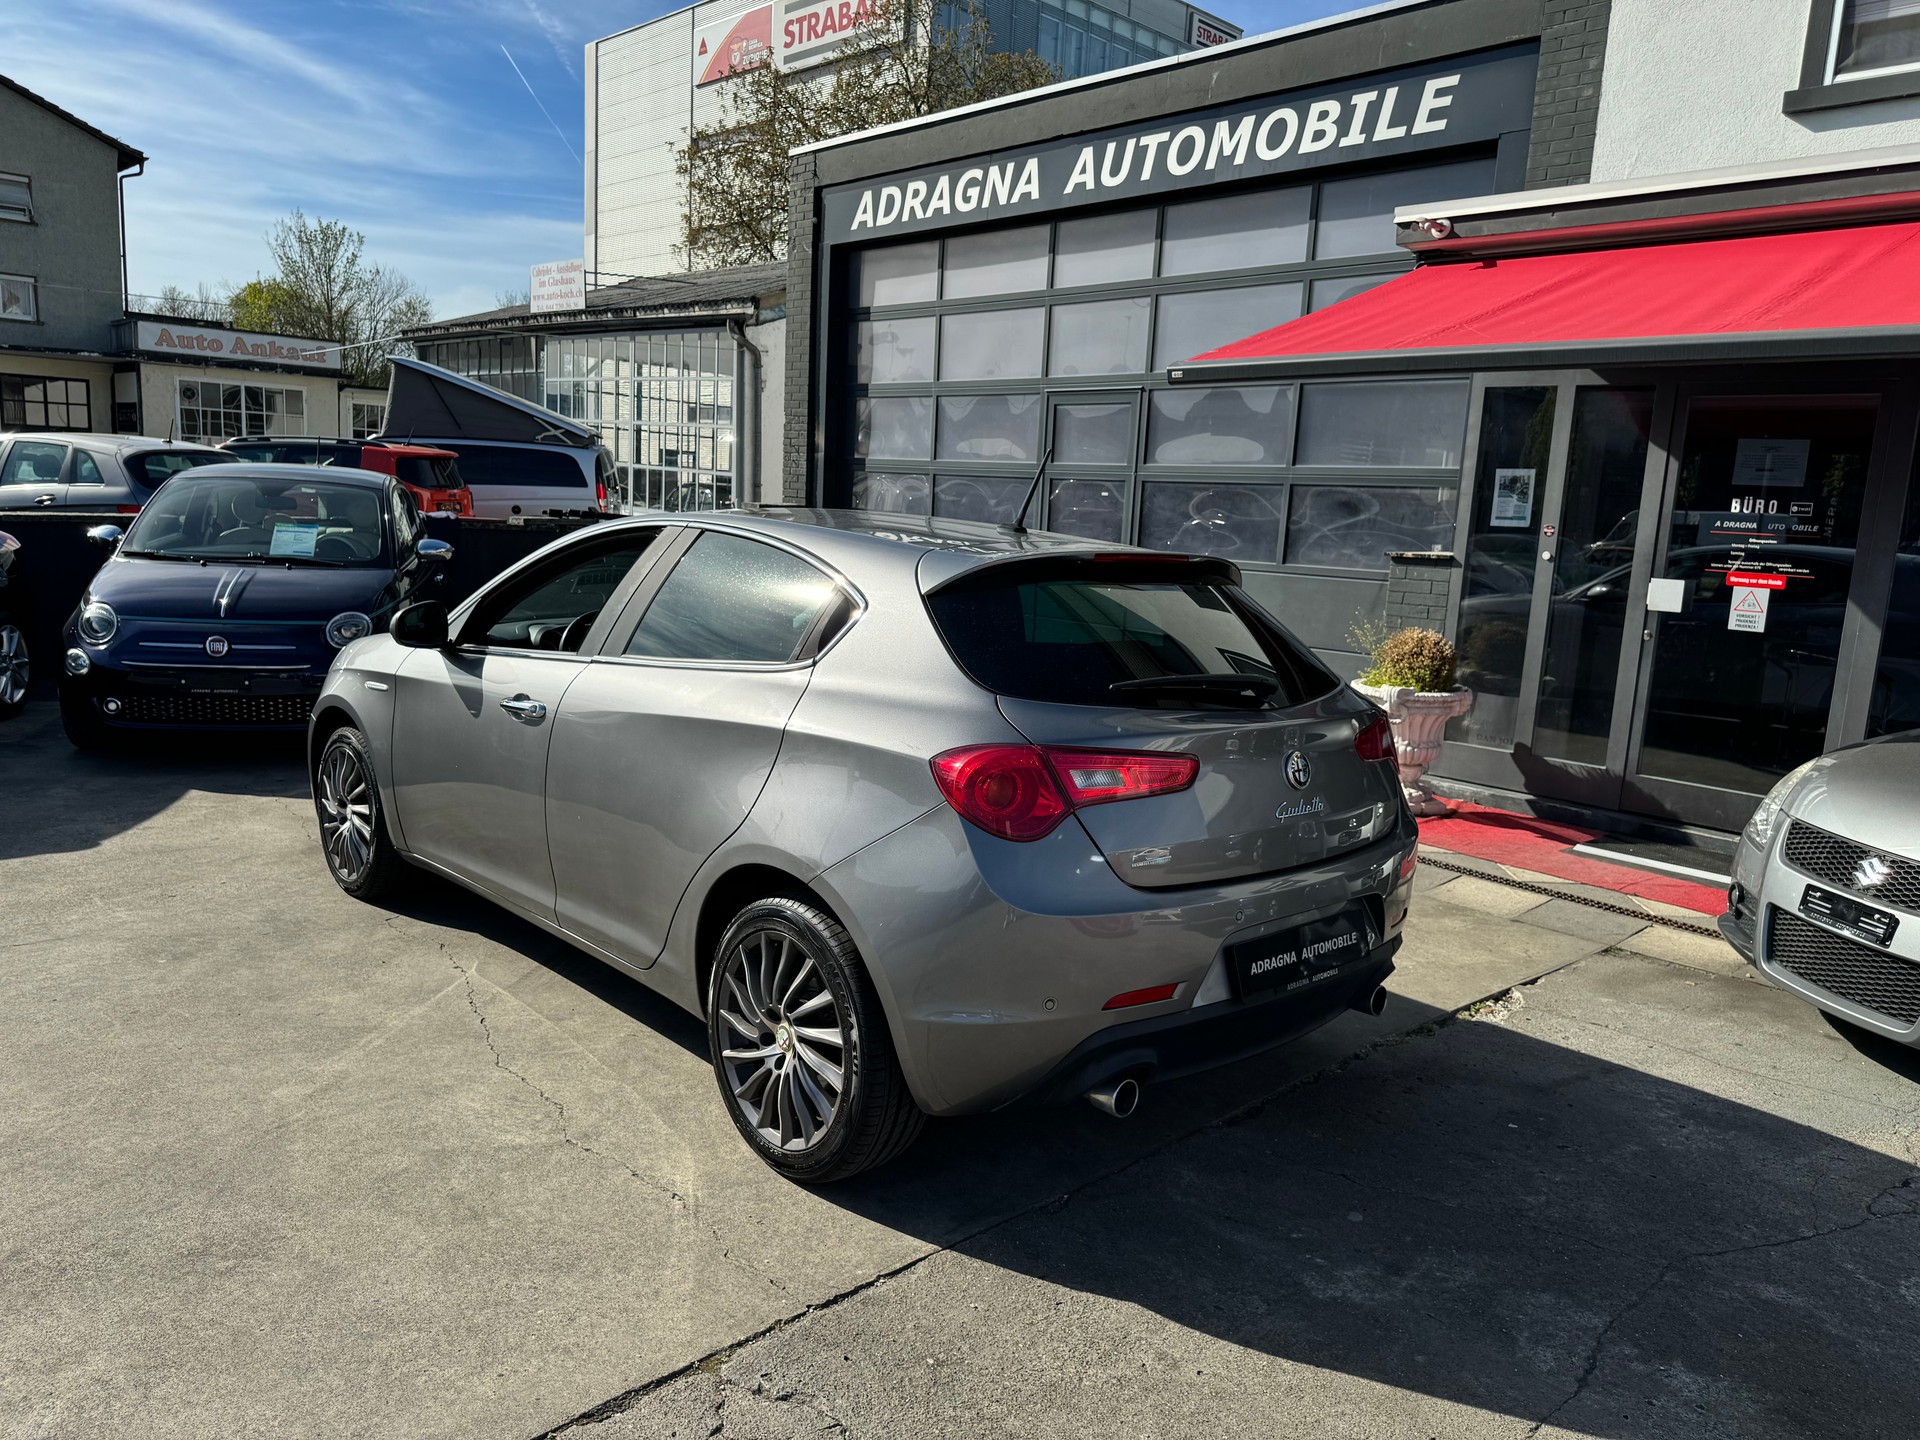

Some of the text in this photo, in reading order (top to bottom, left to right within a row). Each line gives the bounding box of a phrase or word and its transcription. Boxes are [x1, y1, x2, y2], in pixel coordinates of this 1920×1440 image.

[850, 74, 1462, 231] ADRAGNA AUTOMOBILE
[154, 328, 327, 363] Auto Ankauf
[1730, 496, 1778, 514] BÜRO
[210, 641, 224, 652] FIAT
[1275, 796, 1325, 824] Giulietta
[1250, 931, 1357, 976] ADRAGNA AUTOMOBILE
